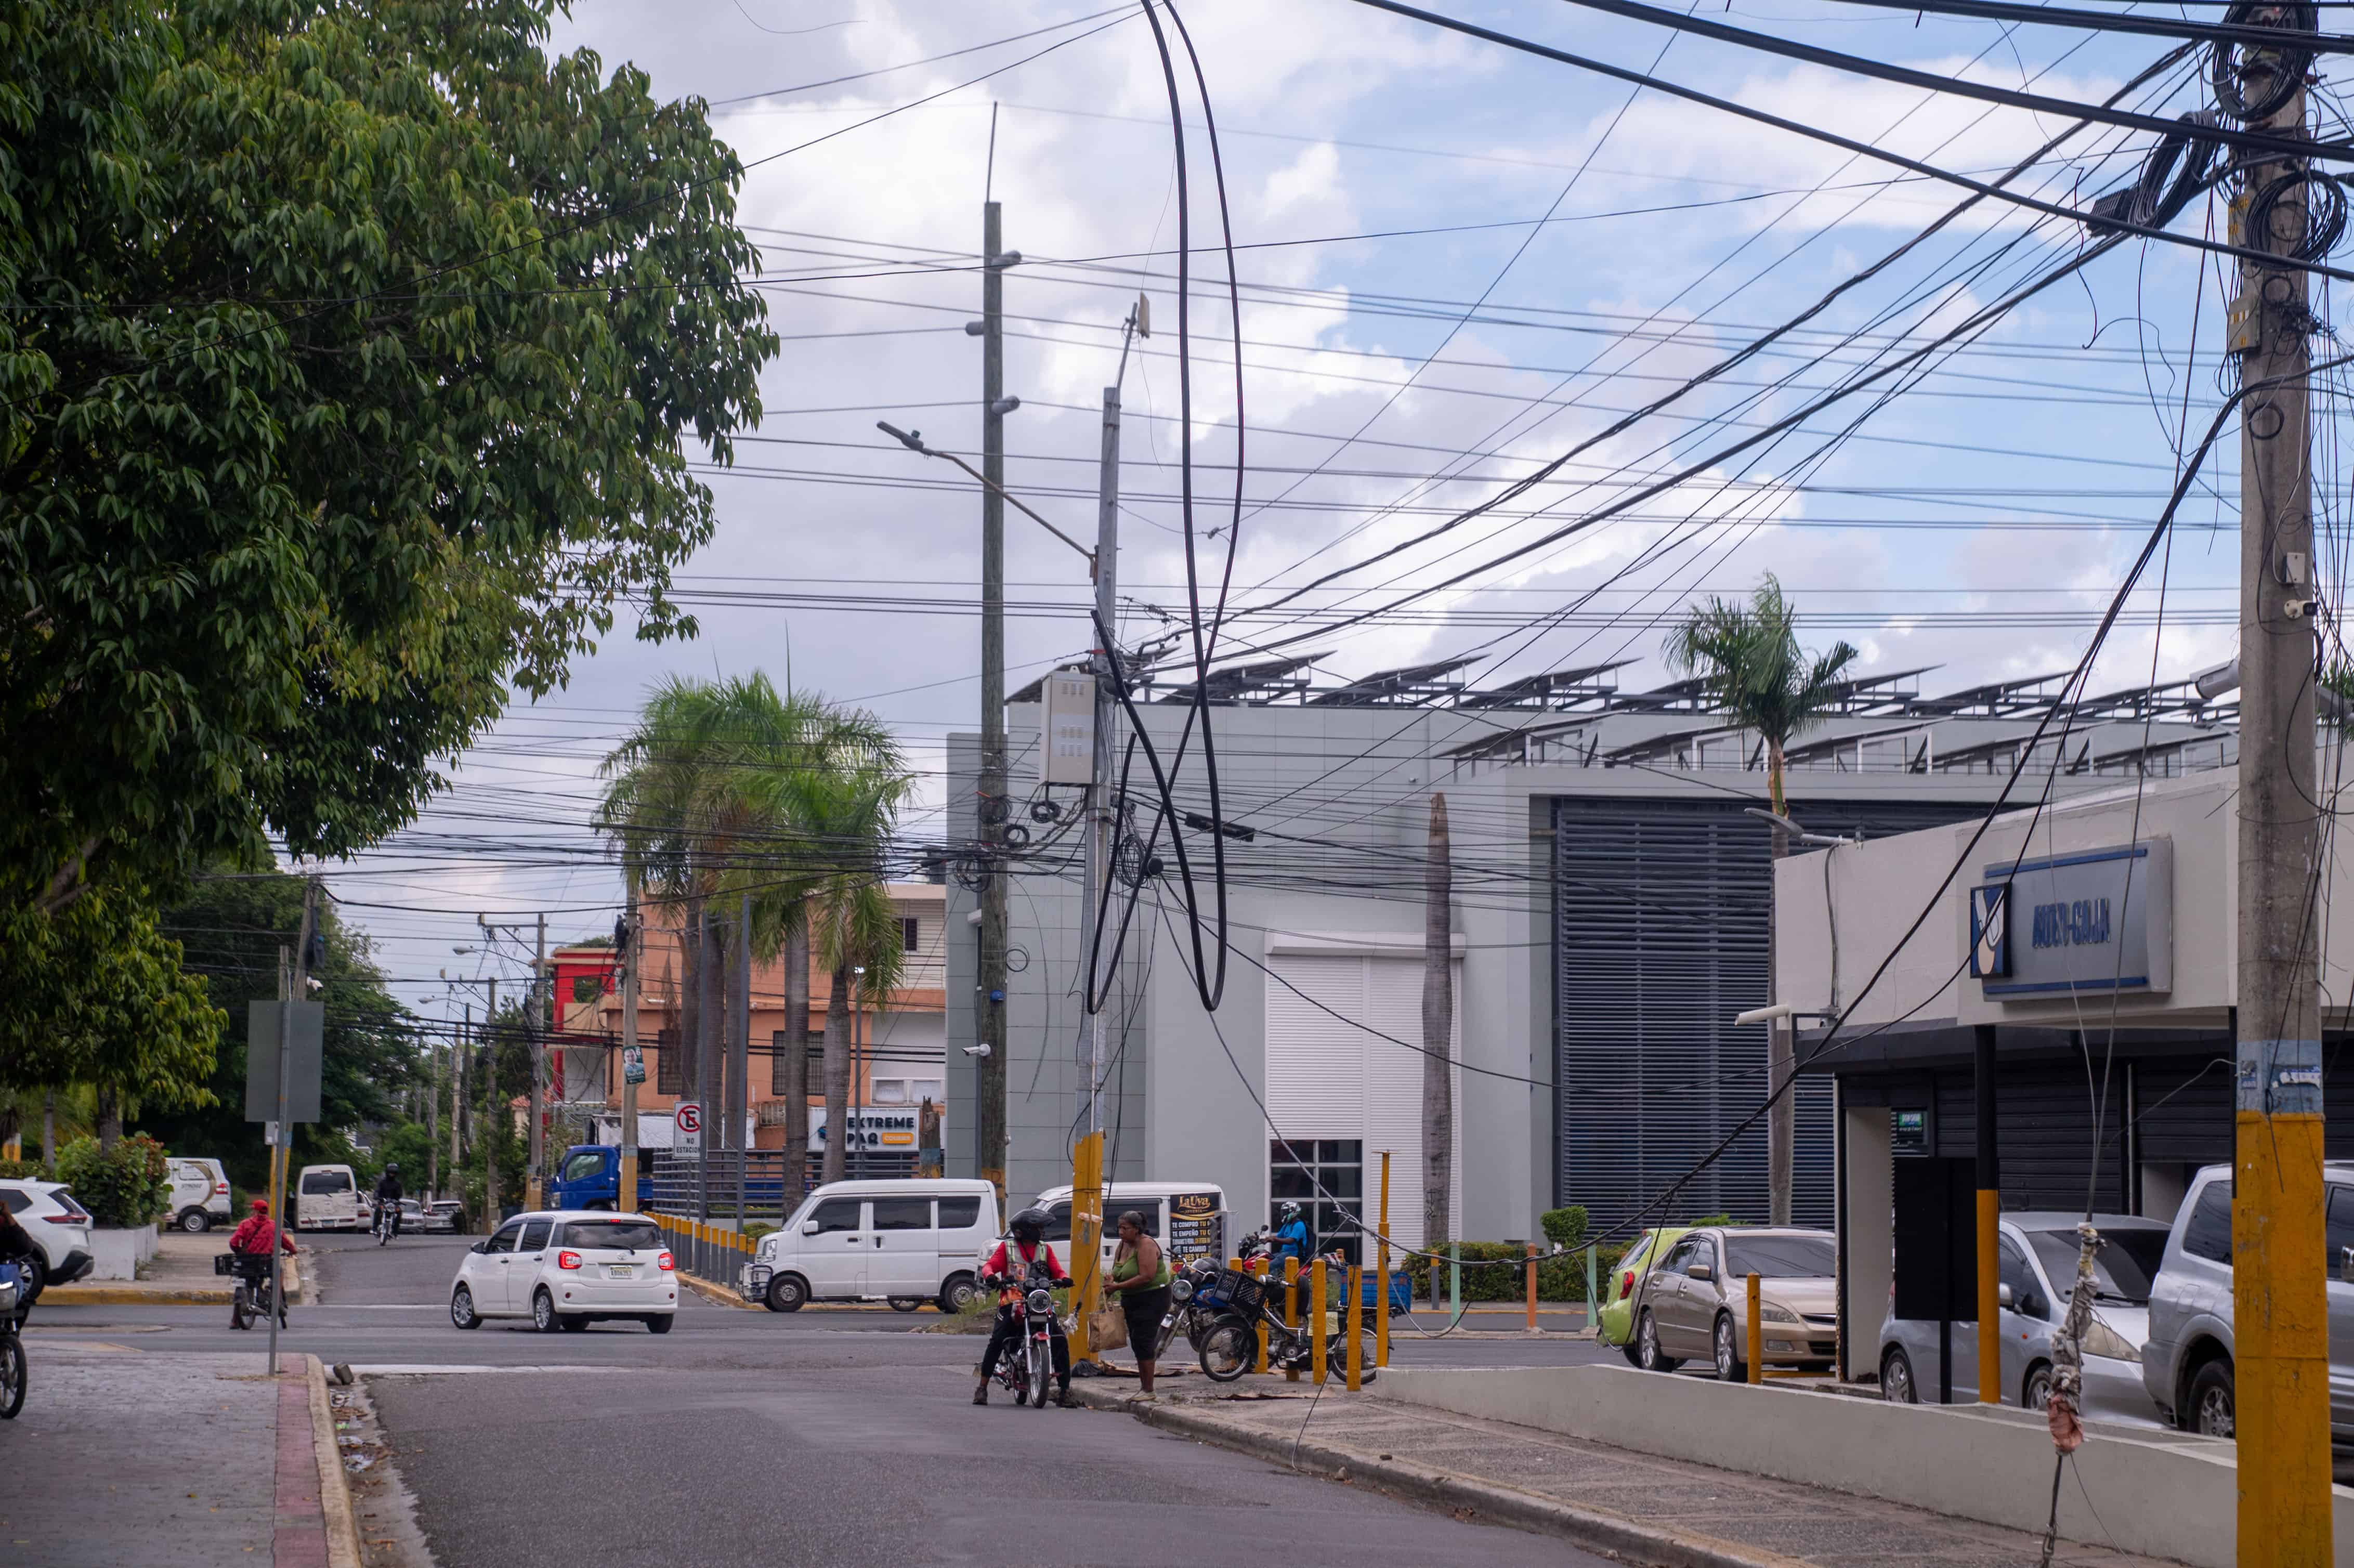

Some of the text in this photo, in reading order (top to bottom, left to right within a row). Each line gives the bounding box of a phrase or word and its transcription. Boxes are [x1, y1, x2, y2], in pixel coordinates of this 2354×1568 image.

[2032, 899, 2110, 948] AUTO-CAJA
[847, 1117, 914, 1128] EXTREME
[847, 1132, 878, 1144] PAQ
